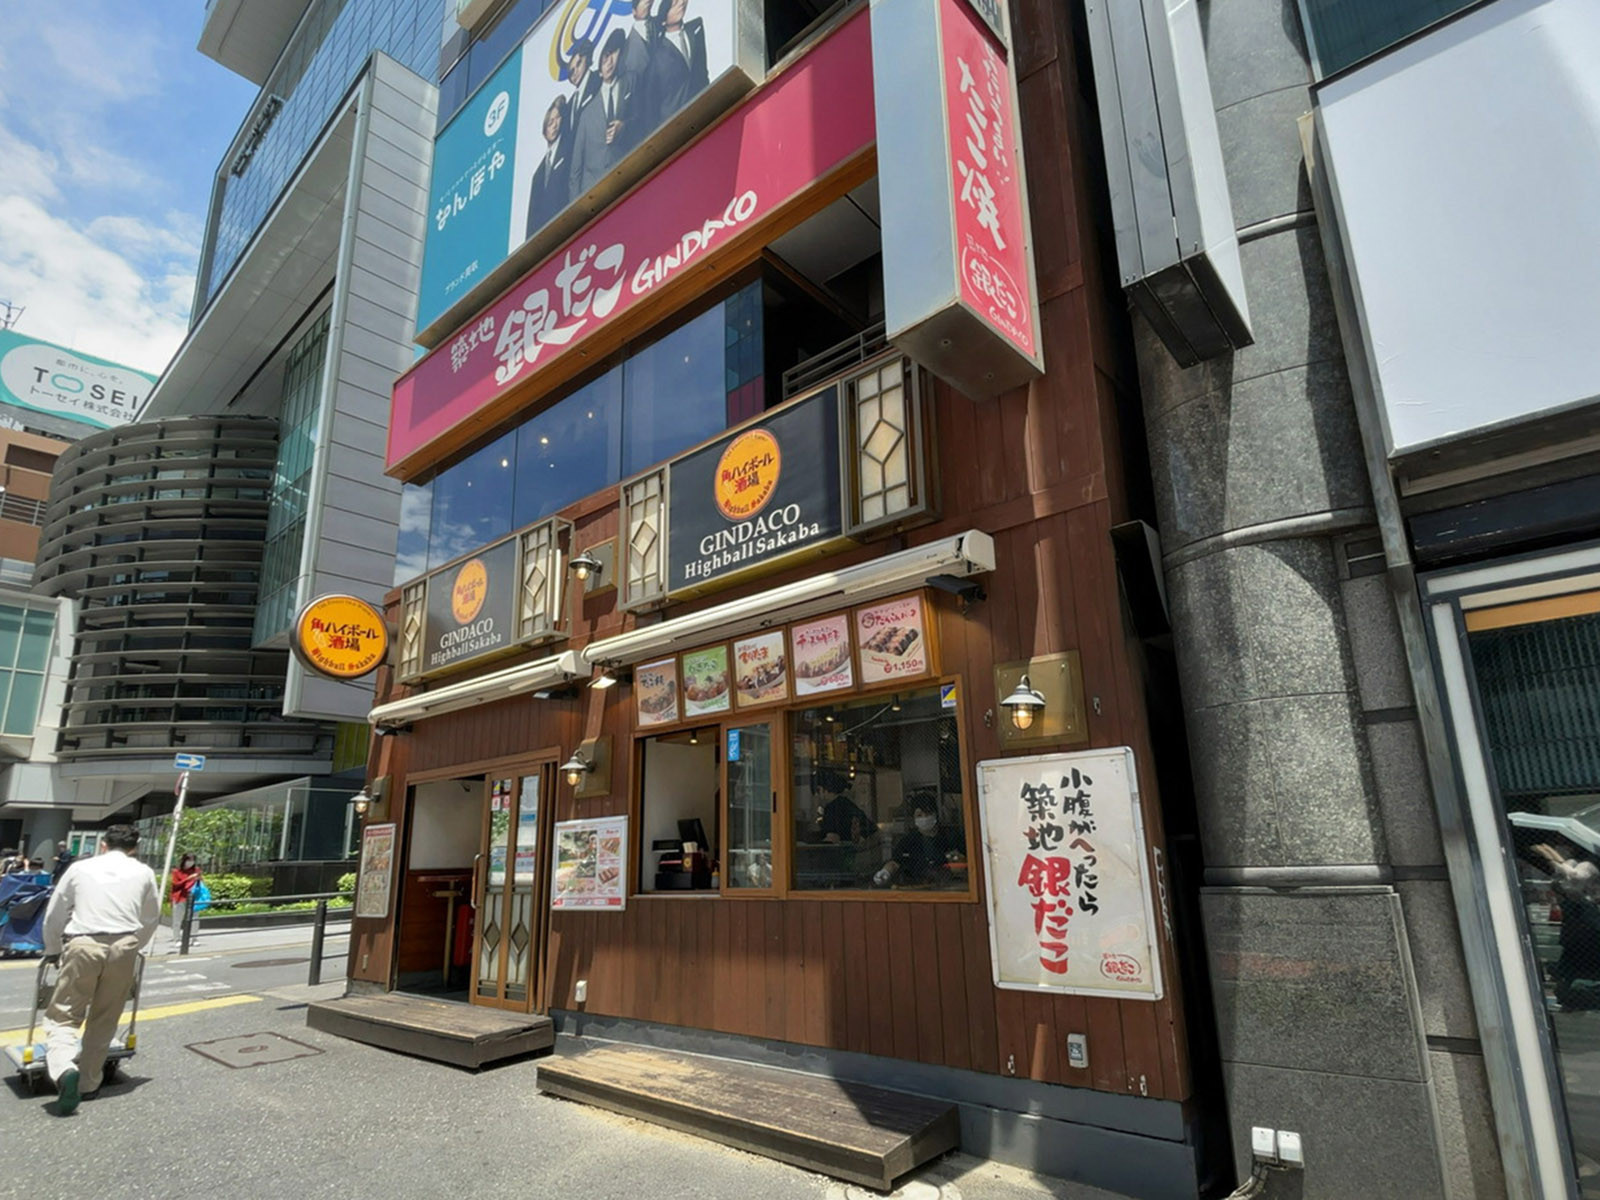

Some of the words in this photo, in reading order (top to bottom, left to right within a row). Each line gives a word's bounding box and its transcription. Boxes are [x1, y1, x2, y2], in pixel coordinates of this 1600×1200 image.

[487, 98, 506, 129] 3F
[957, 56, 1007, 250] たこ焼
[436, 150, 505, 231] なんぼや
[450, 315, 495, 374] 築地
[493, 243, 627, 386] 銀だこ
[631, 190, 758, 295] GINDACO
[969, 258, 1017, 319] 銀だこ
[722, 452, 775, 484] 角ハイボール
[735, 471, 760, 494] 酒場
[700, 503, 801, 556] GINDACO
[684, 541, 754, 580] Highball
[755, 522, 820, 554] Sakaba
[311, 617, 379, 640] 角ハイボール
[328, 634, 360, 652] 酒場
[440, 617, 494, 649] GINDACO
[430, 644, 468, 666] Highball
[469, 632, 502, 651] Sakaba
[1060, 767, 1099, 916] 小腹がへったら
[1105, 960, 1135, 975] 銀だこ
